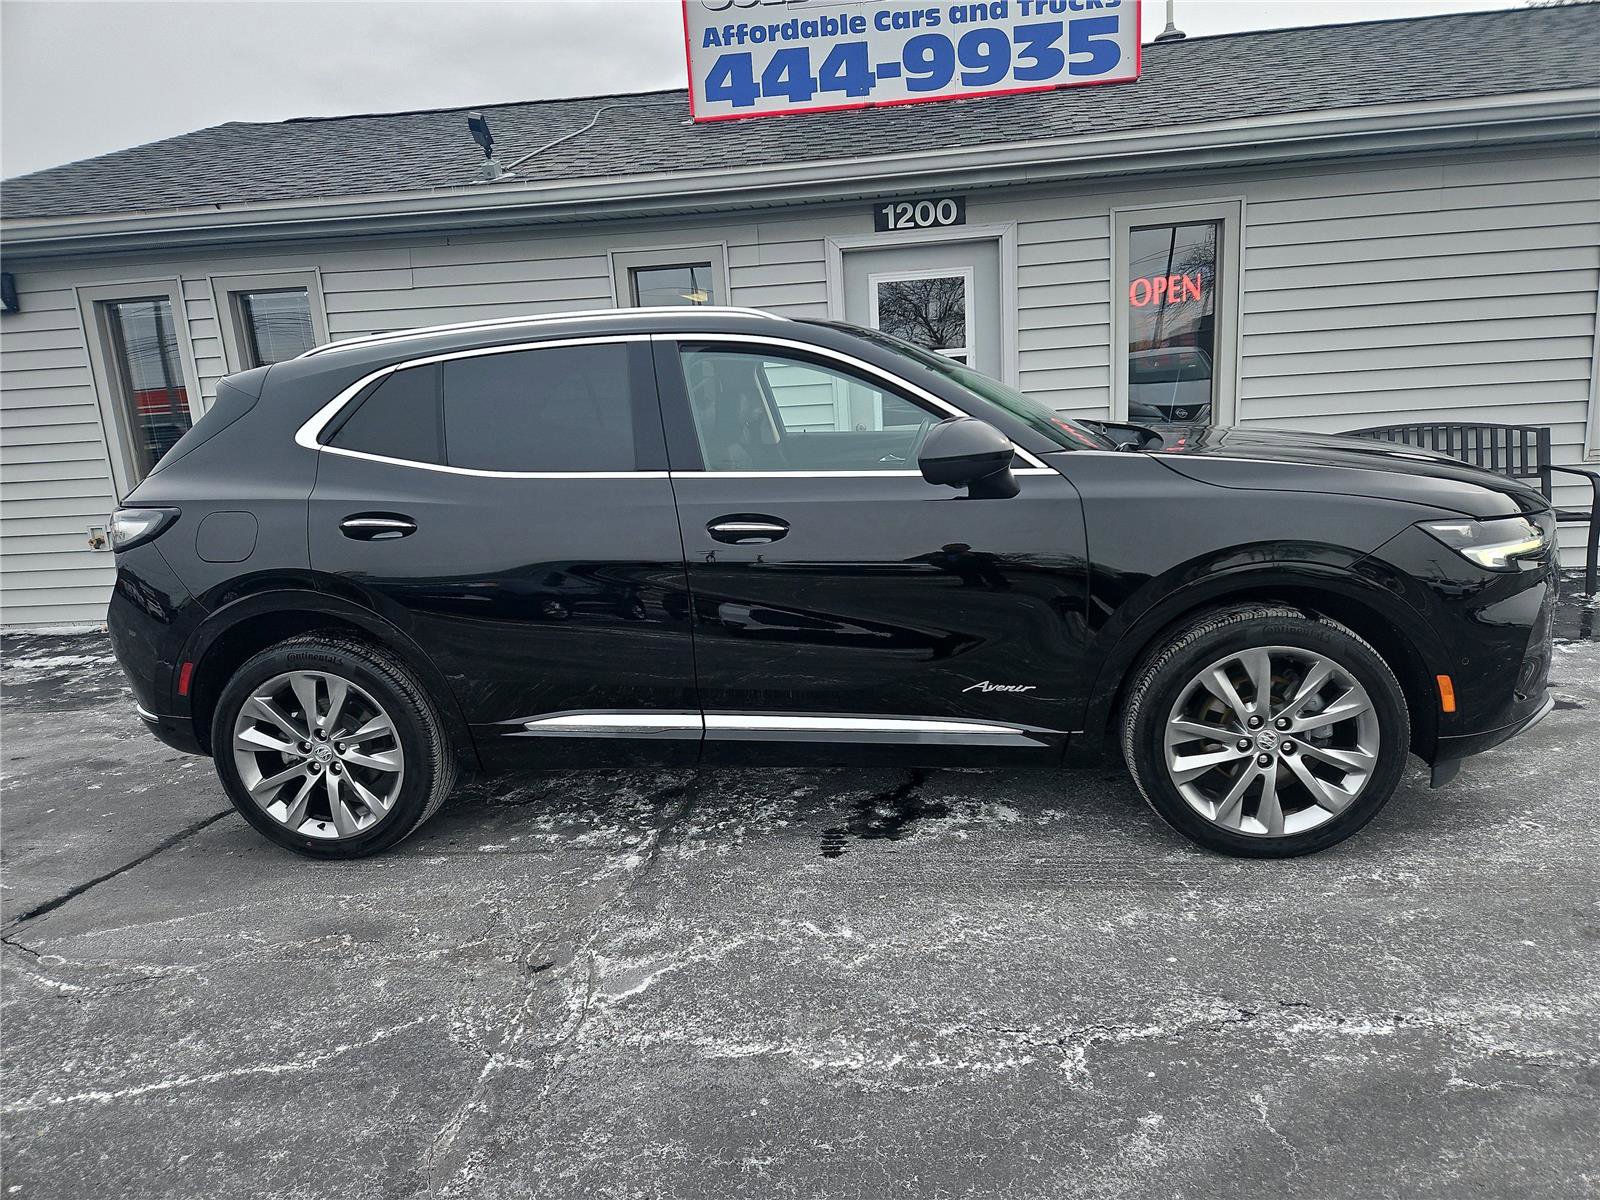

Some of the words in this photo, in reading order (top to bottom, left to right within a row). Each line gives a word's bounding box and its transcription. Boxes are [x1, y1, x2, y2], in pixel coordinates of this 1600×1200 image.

[702, 13, 867, 49] Affordable
[873, 8, 941, 32] Cars
[948, 0, 1009, 25] and
[704, 15, 1122, 108] 444-9935
[882, 198, 958, 229] 1200
[1128, 272, 1202, 307] OPEN
[962, 680, 1037, 693] Avenir
